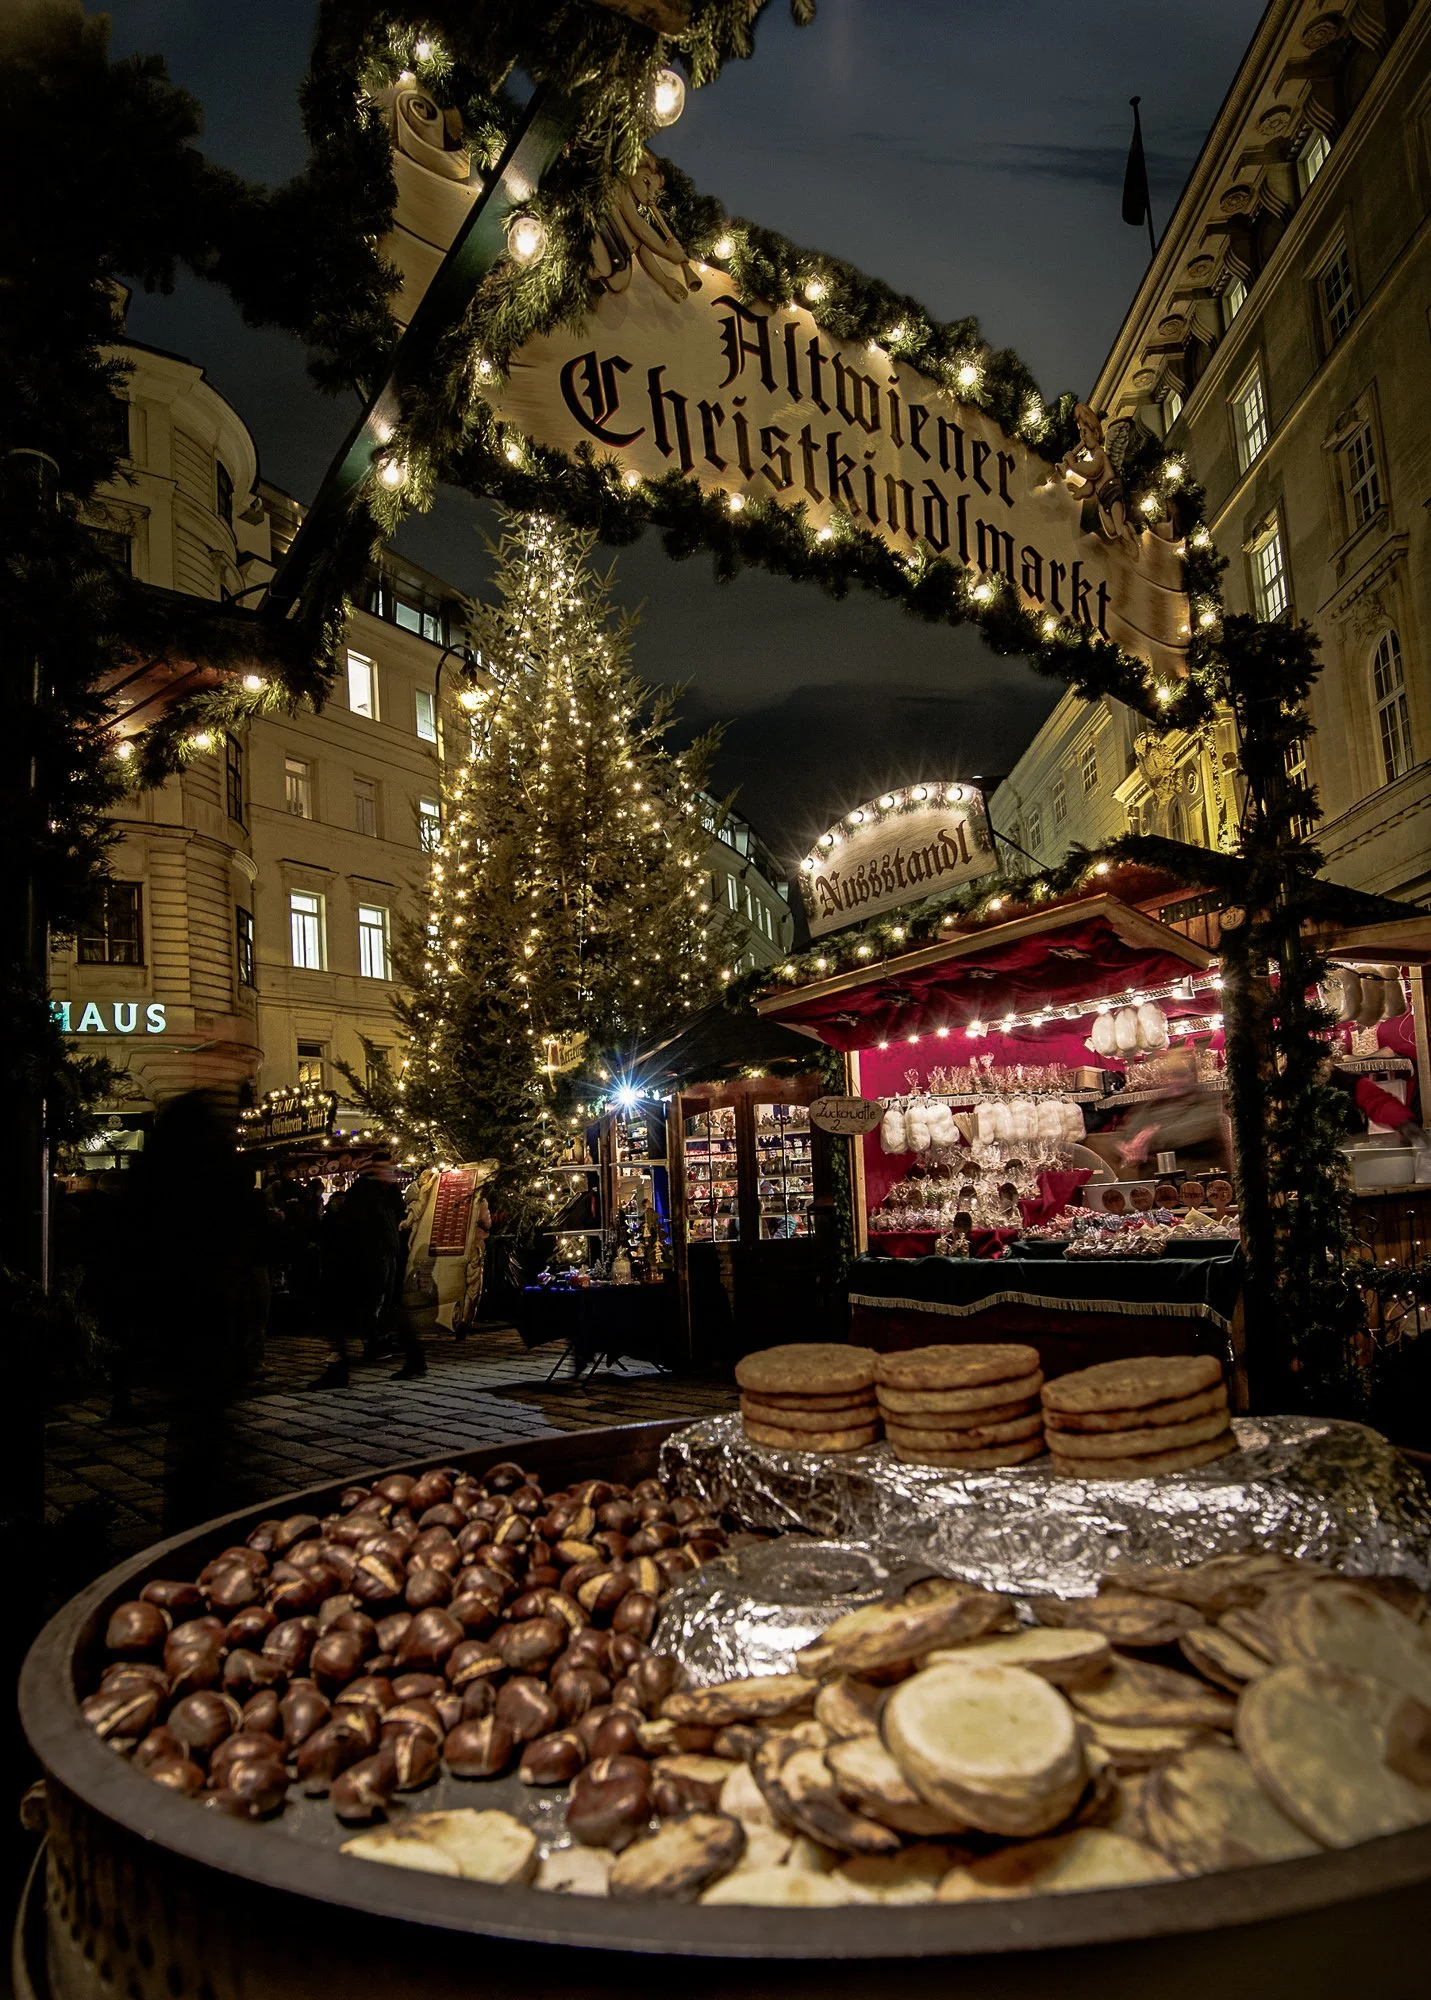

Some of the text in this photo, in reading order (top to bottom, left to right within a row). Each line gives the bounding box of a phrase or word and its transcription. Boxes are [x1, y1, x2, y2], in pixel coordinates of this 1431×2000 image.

[711, 295, 1016, 508] Altwiener
[559, 351, 1111, 640] Christkindlmarkt
[815, 819, 973, 919] Nussstandl
[1226, 912, 1237, 924] 21
[815, 1100, 876, 1120] Zuckerwatte
